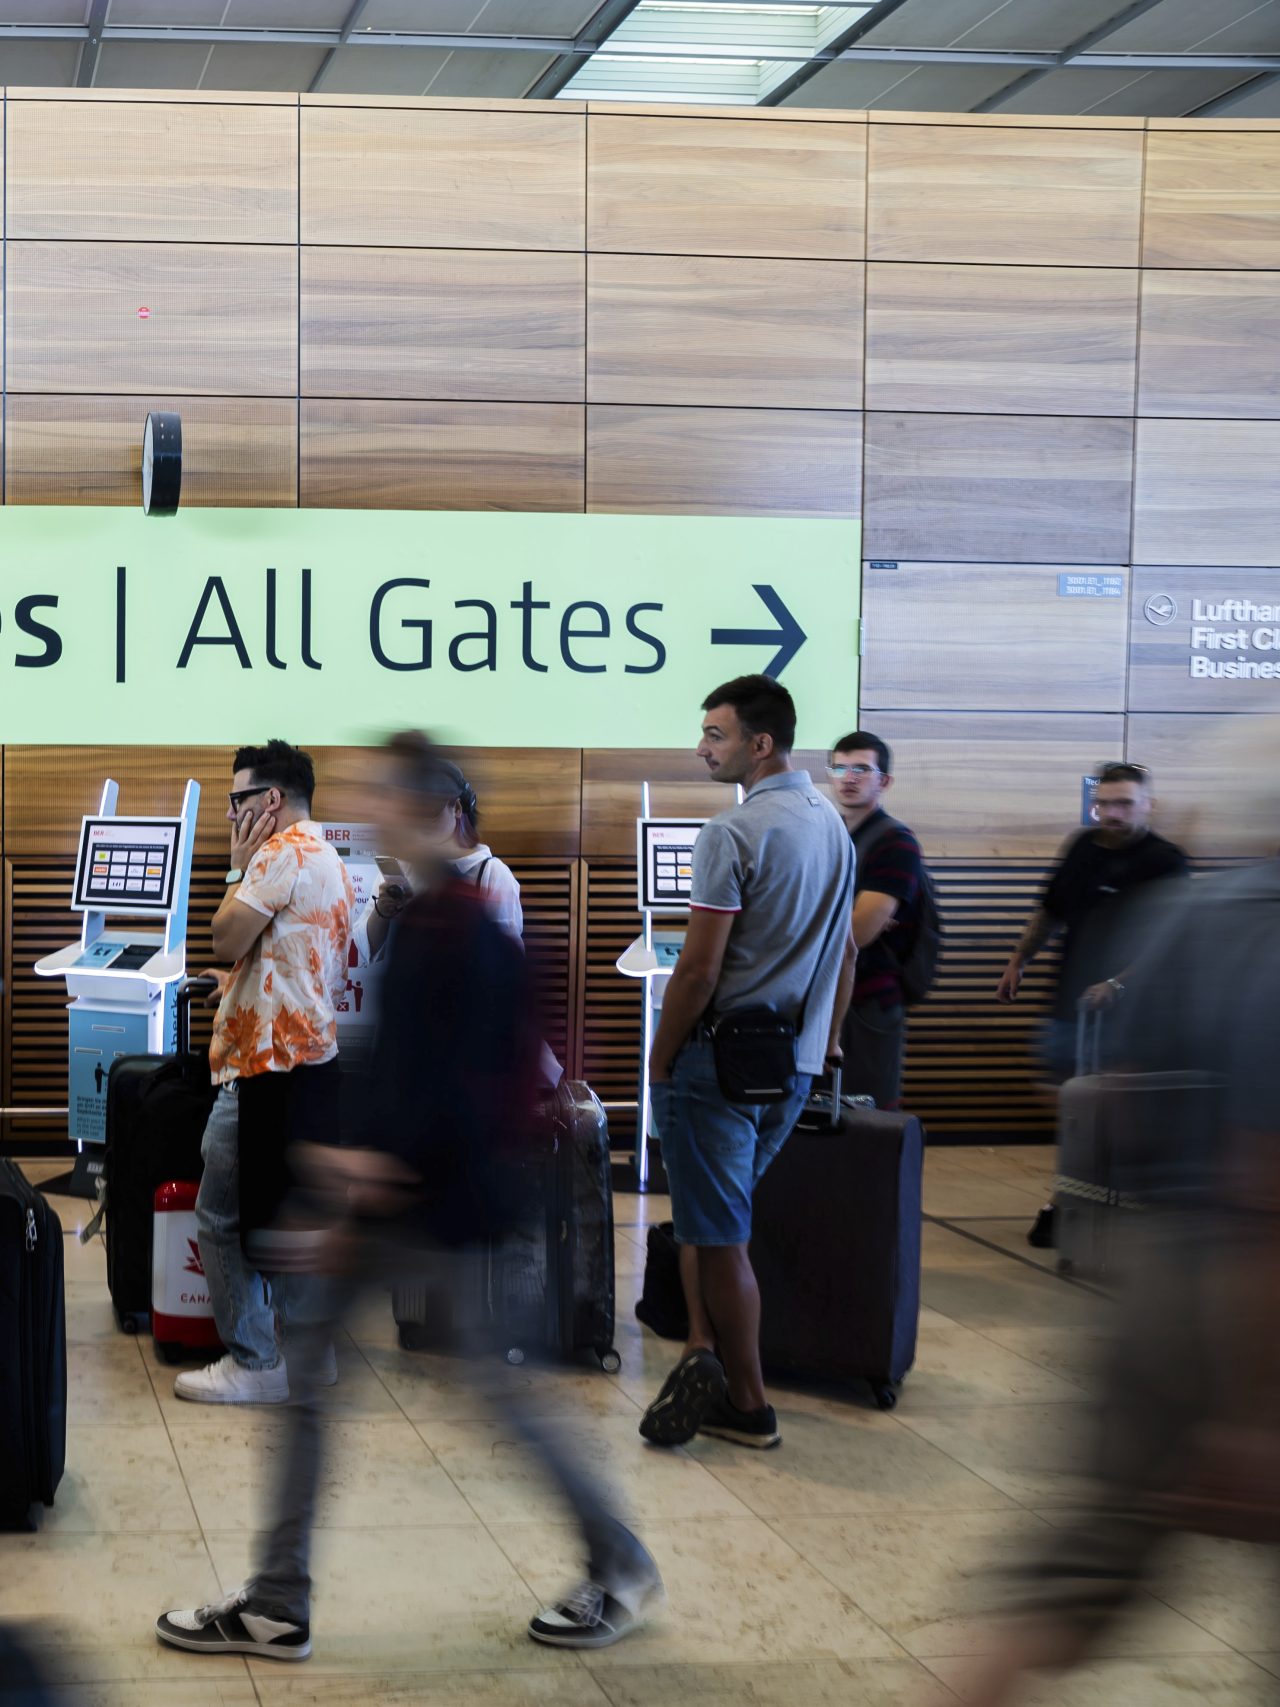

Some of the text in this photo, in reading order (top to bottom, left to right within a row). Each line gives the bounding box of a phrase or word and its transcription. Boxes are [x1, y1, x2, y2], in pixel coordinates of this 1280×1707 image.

[175, 567, 323, 671] All
[369, 577, 667, 675] Gates
[1190, 626, 1249, 650] First
[325, 829, 350, 841] BER
